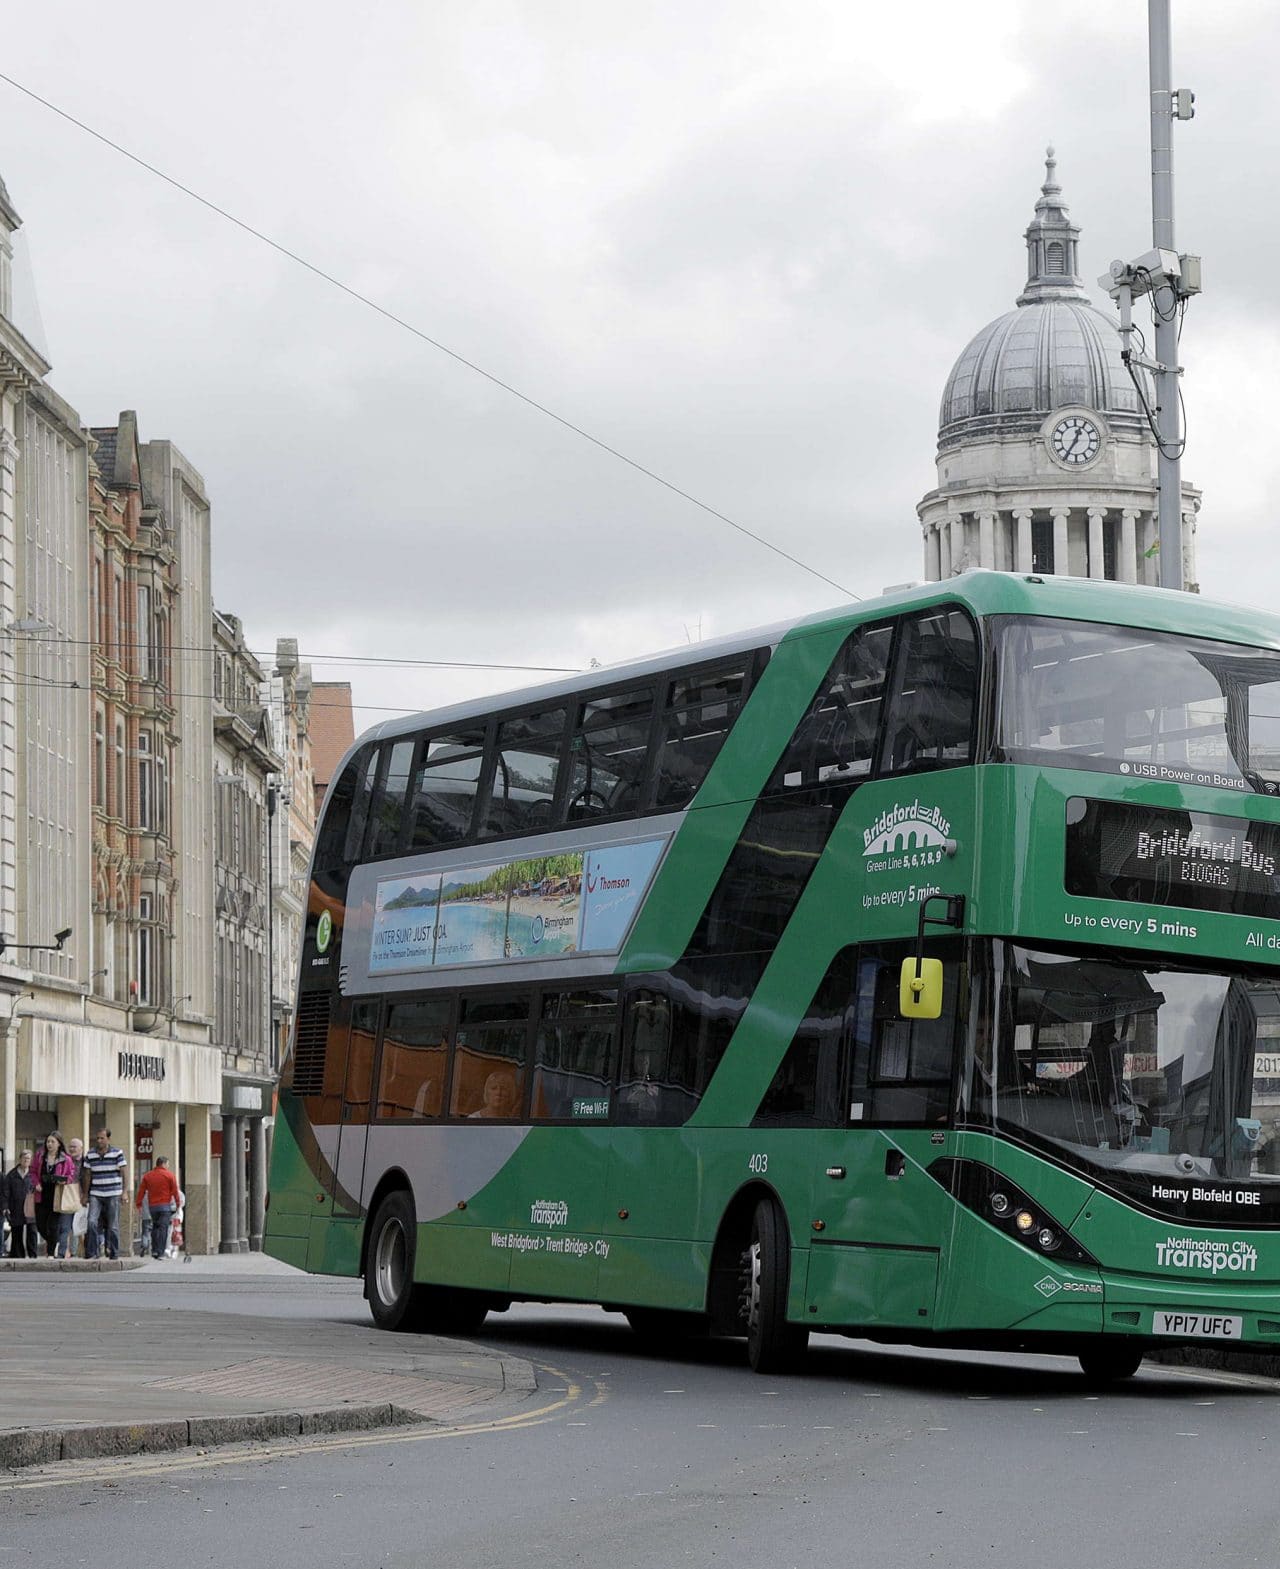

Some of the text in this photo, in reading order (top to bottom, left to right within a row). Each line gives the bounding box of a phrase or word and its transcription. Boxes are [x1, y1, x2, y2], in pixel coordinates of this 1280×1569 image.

[1133, 764, 1245, 788] USB Power on Board
[863, 799, 951, 848] Bridgford Bus
[866, 860, 887, 873] Green
[888, 857, 902, 870] Line
[935, 850, 941, 863] 9
[1137, 829, 1275, 876] Bridgford Bus
[600, 876, 630, 890] Thomson
[1181, 862, 1230, 885] BIOGAS
[863, 894, 872, 909] Up
[873, 895, 880, 906] to
[881, 889, 907, 907] every
[908, 885, 915, 902] 5
[396, 927, 412, 944] SUN?
[413, 925, 431, 942] JUST
[1064, 913, 1197, 938] Up to every 5 mins
[1246, 932, 1264, 947] All
[118, 1052, 166, 1081] DEBENHAMS
[580, 1102, 608, 1114] Free Wi-Fi
[749, 1153, 768, 1173] 403
[536, 1200, 568, 1212] Nottingham City
[1152, 1185, 1261, 1205] Henry Blofeld OBE
[531, 1205, 568, 1229] Transport
[491, 1232, 507, 1248] West
[508, 1233, 539, 1253] Bridgford
[546, 1237, 564, 1252] Trent
[565, 1238, 588, 1257] Bridge
[595, 1240, 610, 1259] City
[1167, 1237, 1254, 1255] Nottingham City
[1155, 1242, 1257, 1275] Transport
[1063, 1282, 1103, 1293] SCANIA
[1164, 1315, 1233, 1335] YP17 UFC
